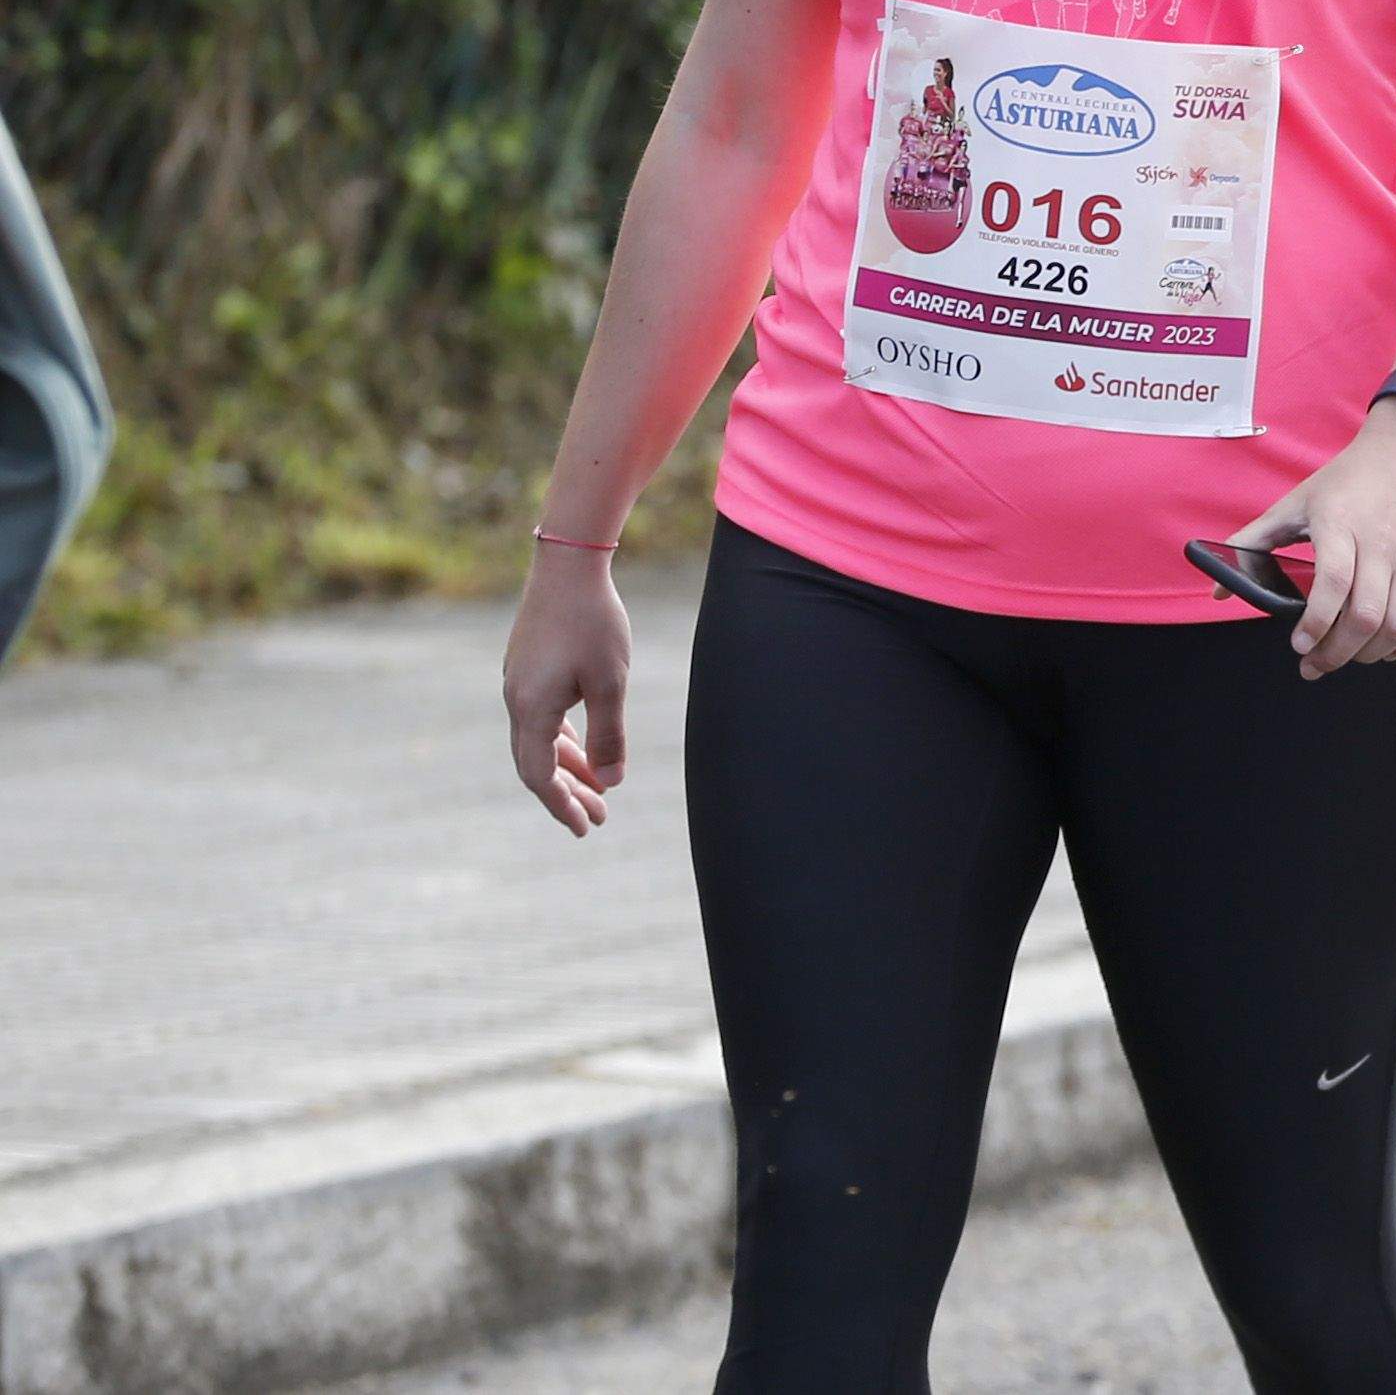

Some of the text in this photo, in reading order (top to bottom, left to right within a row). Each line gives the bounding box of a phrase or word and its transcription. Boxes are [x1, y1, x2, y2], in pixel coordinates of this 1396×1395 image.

[1011, 89, 1137, 113] CENTRAL LECHERA
[1173, 99, 1245, 120] SUMA
[1175, 86, 1250, 99] TU DORSAL
[984, 88, 1139, 139] ASTURIANA
[981, 181, 1122, 245] 016
[1022, 239, 1067, 252] VIOLENCIA
[1069, 245, 1080, 253] DE
[997, 256, 1089, 295] 4226
[889, 286, 1217, 346] CARRERA DE LA MUJER 2023
[876, 335, 982, 382] OYSHO
[1090, 372, 1220, 403] Santander
